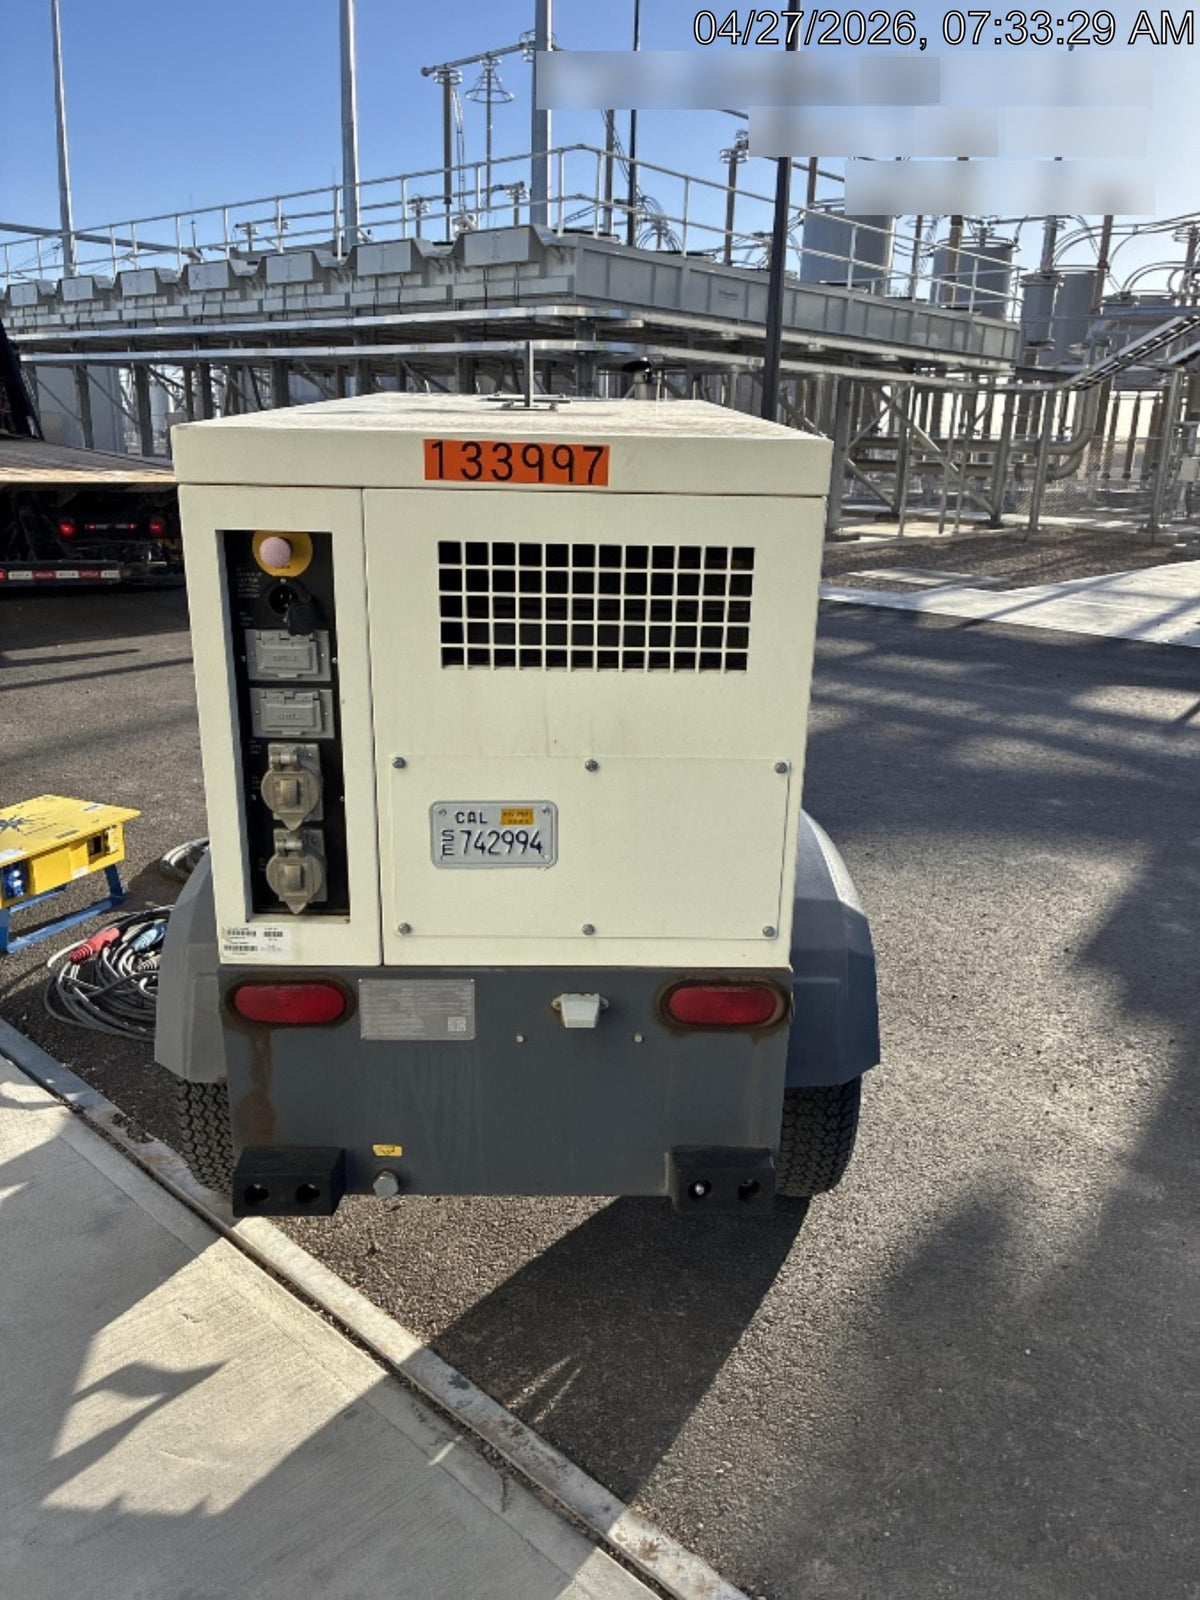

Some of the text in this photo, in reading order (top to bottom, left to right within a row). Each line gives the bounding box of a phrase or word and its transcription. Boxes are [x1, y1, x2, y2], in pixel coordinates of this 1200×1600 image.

[432, 440, 604, 484] 133997
[455, 811, 488, 824] CAL
[441, 829, 543, 856] SE 742994
